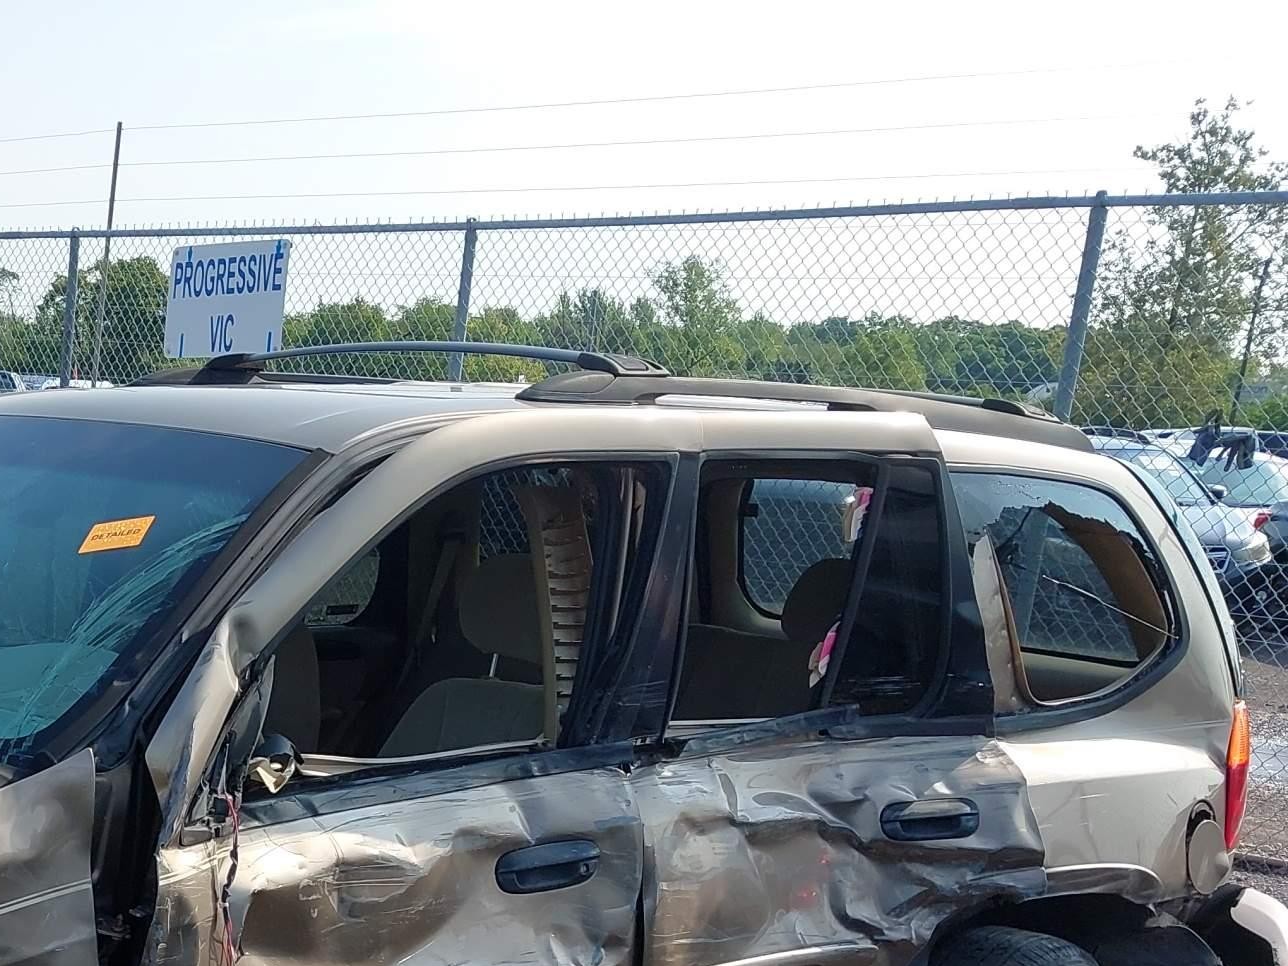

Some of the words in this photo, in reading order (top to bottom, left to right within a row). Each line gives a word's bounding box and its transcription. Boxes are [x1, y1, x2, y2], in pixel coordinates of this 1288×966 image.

[172, 253, 285, 299] PROGRESSIVE
[210, 314, 235, 353] VIC
[91, 528, 142, 541] DETAILED
